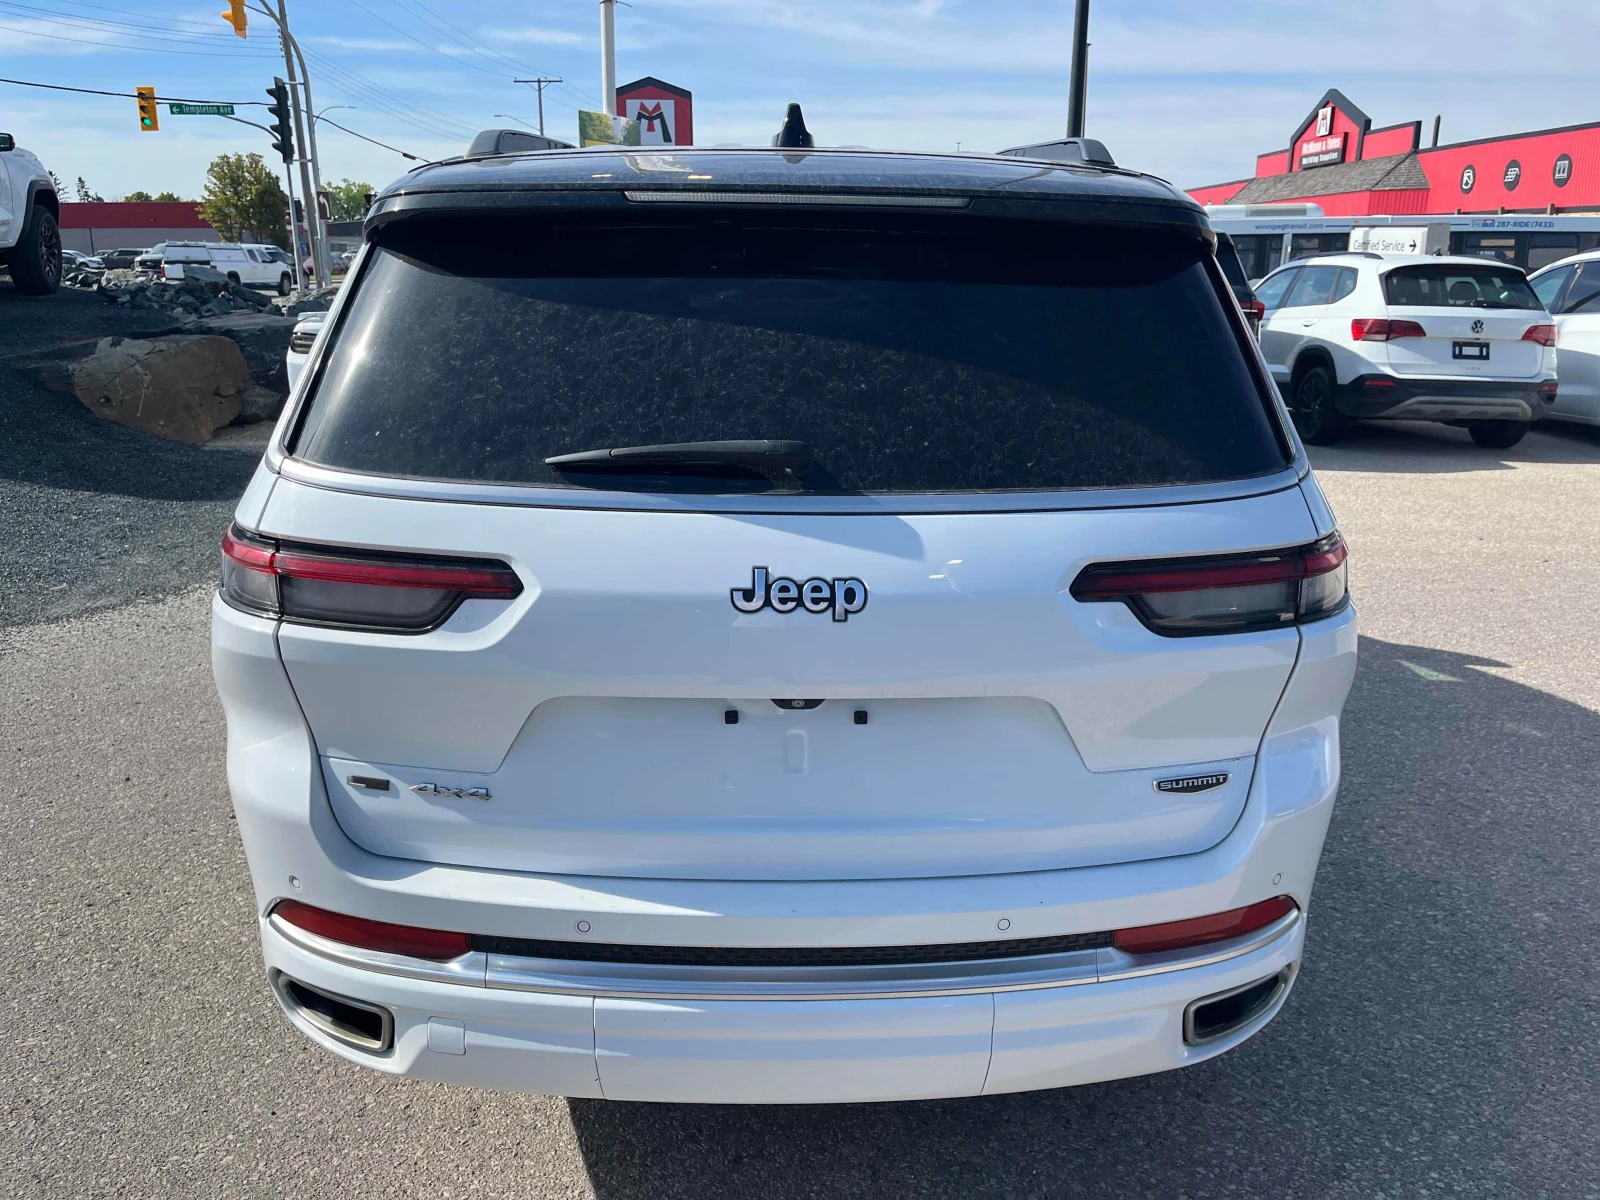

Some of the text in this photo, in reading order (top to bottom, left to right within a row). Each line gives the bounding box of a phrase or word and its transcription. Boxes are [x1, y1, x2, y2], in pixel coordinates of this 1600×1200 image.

[183, 105, 232, 115] Templeton Ave
[1255, 223, 1324, 231] winnipegtransit.com
[1353, 239, 1405, 252] Certified Service
[730, 566, 869, 622] Jeep
[1159, 775, 1227, 790] SUMMIT
[409, 782, 493, 801] 4x4
